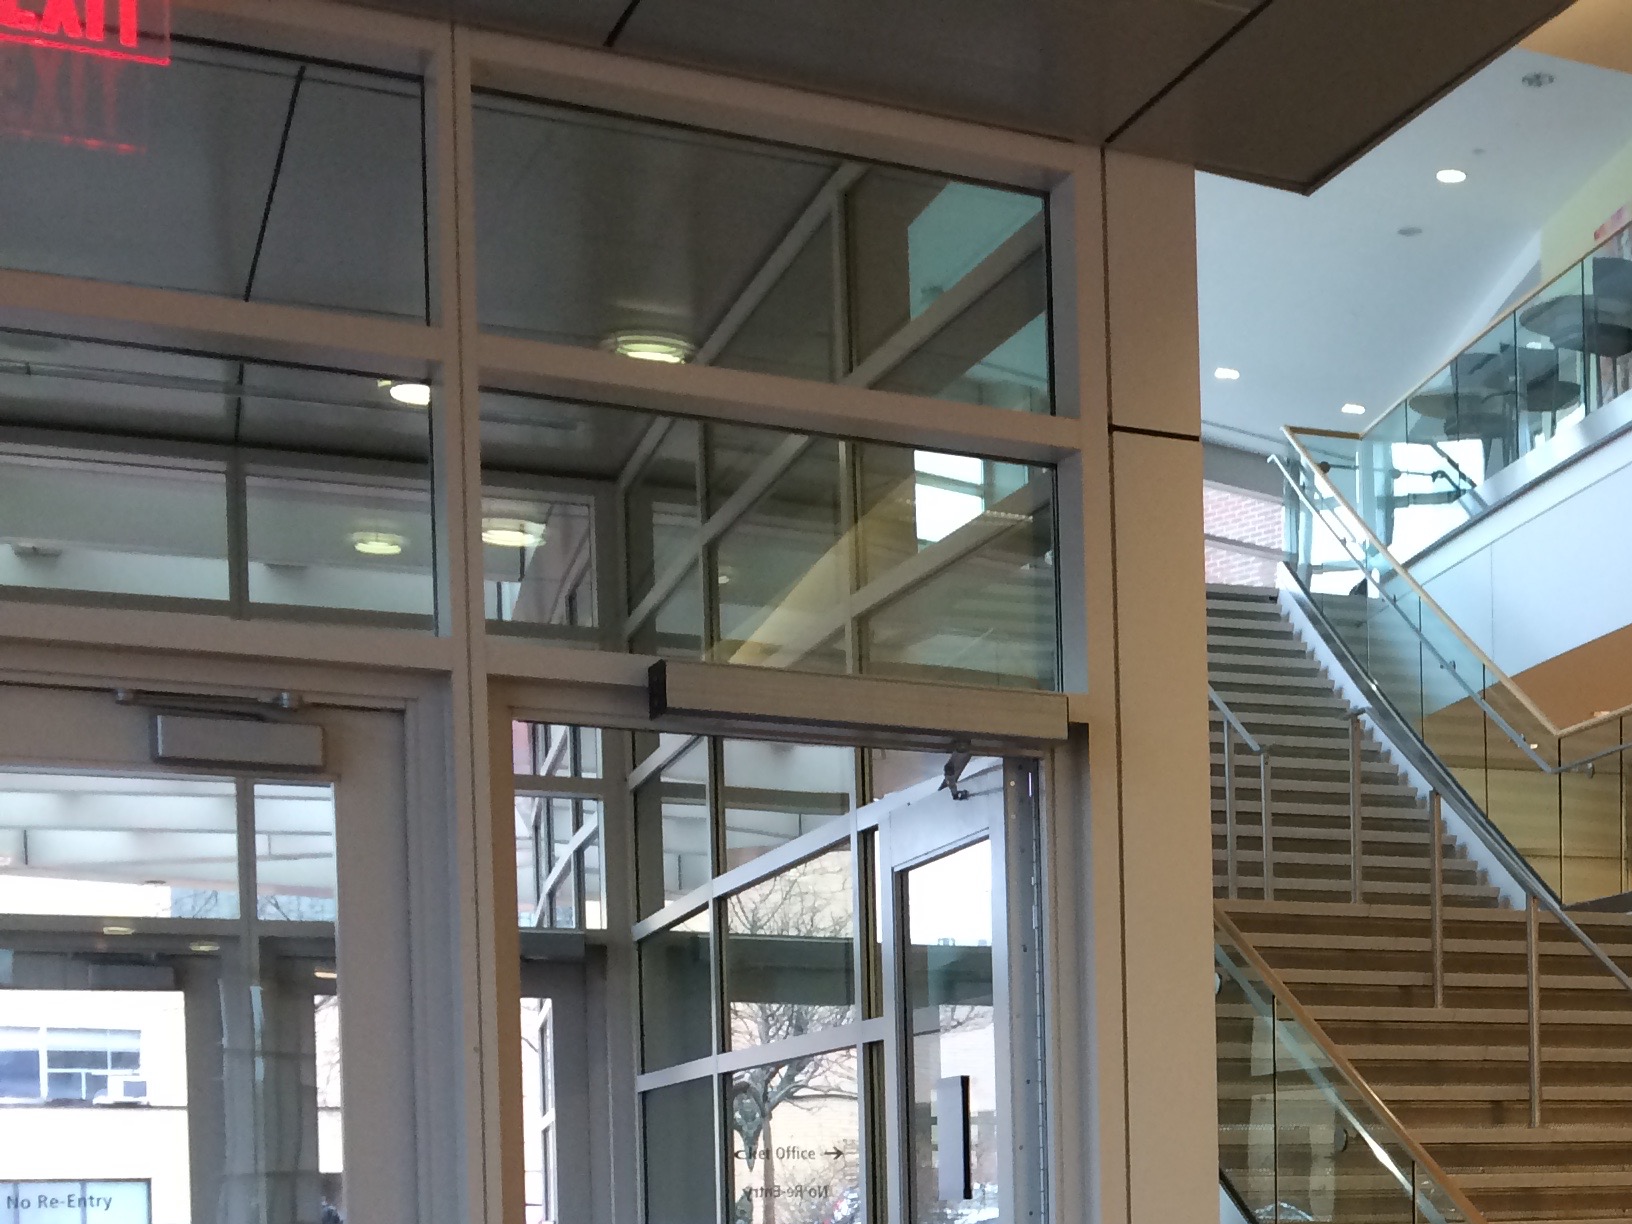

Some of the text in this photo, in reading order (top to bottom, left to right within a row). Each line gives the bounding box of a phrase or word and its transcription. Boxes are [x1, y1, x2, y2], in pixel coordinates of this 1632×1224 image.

[775, 1146, 816, 1160] Office
[7, 1193, 113, 1211] No Re-Entry
